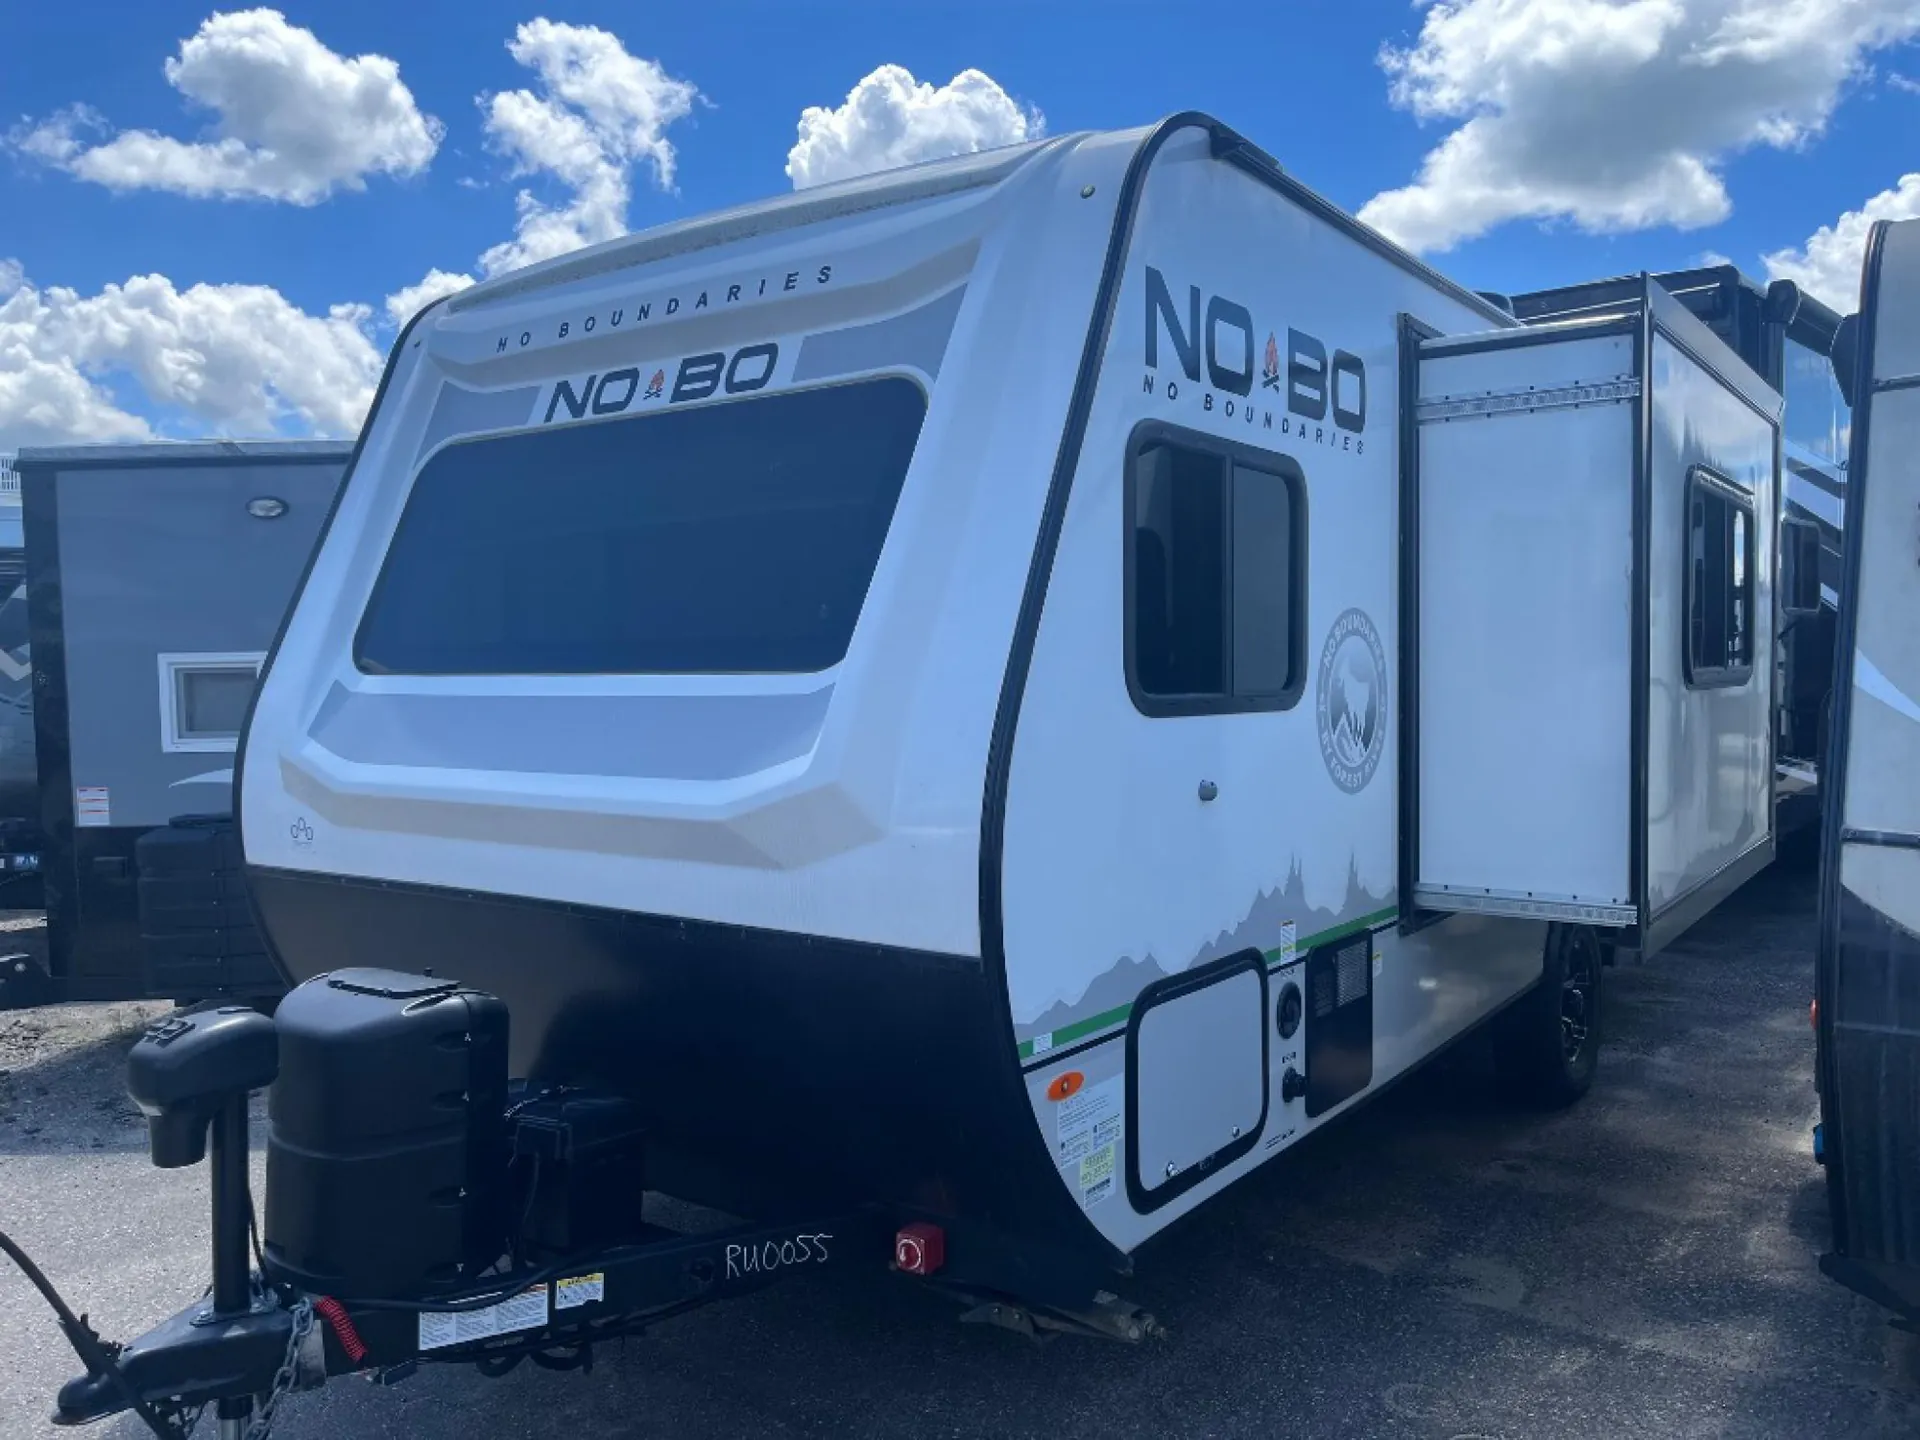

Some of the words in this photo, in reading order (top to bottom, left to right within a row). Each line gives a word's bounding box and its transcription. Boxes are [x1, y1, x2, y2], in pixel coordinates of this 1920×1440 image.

[496, 331, 531, 353] NO
[558, 265, 832, 338] BOUNDARIES
[1143, 374, 1178, 401] NO
[1203, 393, 1364, 455] BOUNDARIES
